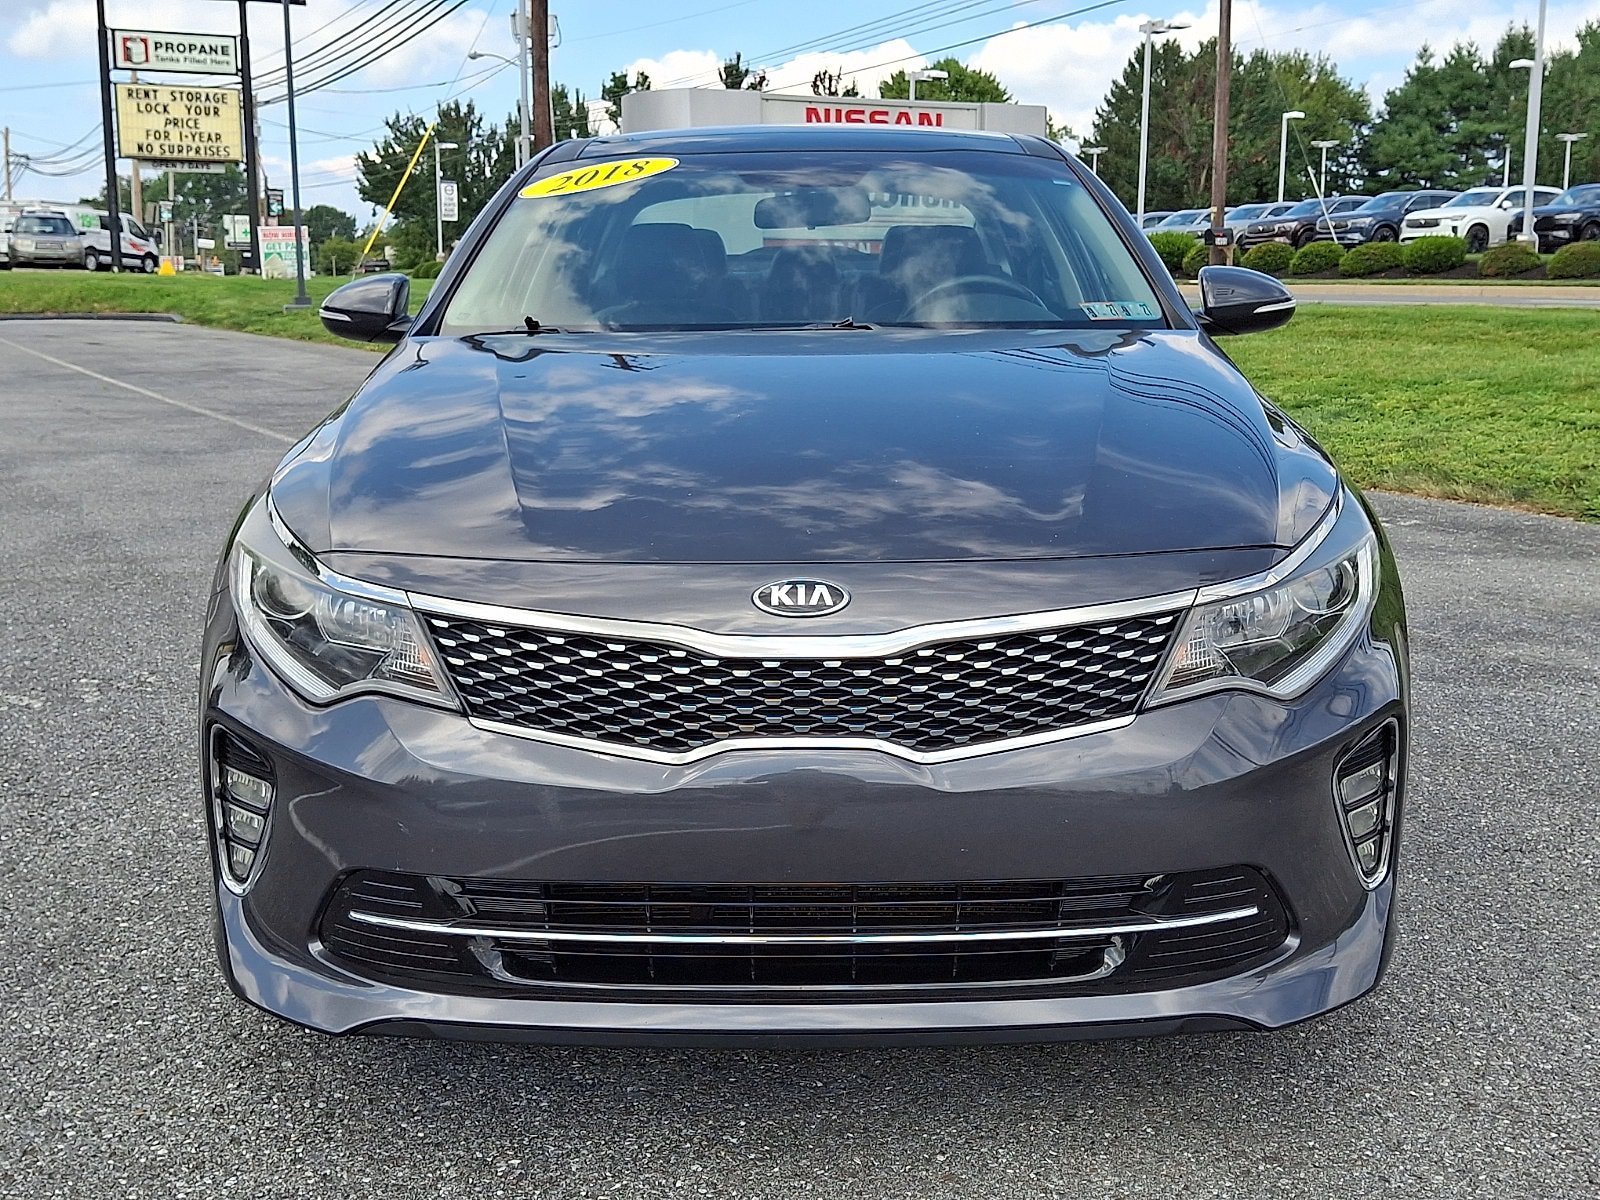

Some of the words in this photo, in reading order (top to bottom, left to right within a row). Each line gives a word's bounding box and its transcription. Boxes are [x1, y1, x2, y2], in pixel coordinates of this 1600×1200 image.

[154, 41, 230, 56] PROPANE
[184, 56, 207, 65] Filled
[127, 88, 158, 100] RENT
[171, 89, 228, 105] STORAGE
[136, 103, 170, 115] LOCK
[185, 105, 220, 117] YOUR
[806, 107, 942, 127] NISSAN
[164, 117, 200, 129] PRICE
[145, 129, 171, 141] FOR
[137, 143, 153, 154] NO
[160, 144, 230, 157] SURPRISES
[546, 160, 650, 194] 2018
[265, 241, 282, 250] GET
[770, 584, 834, 606] KIA
